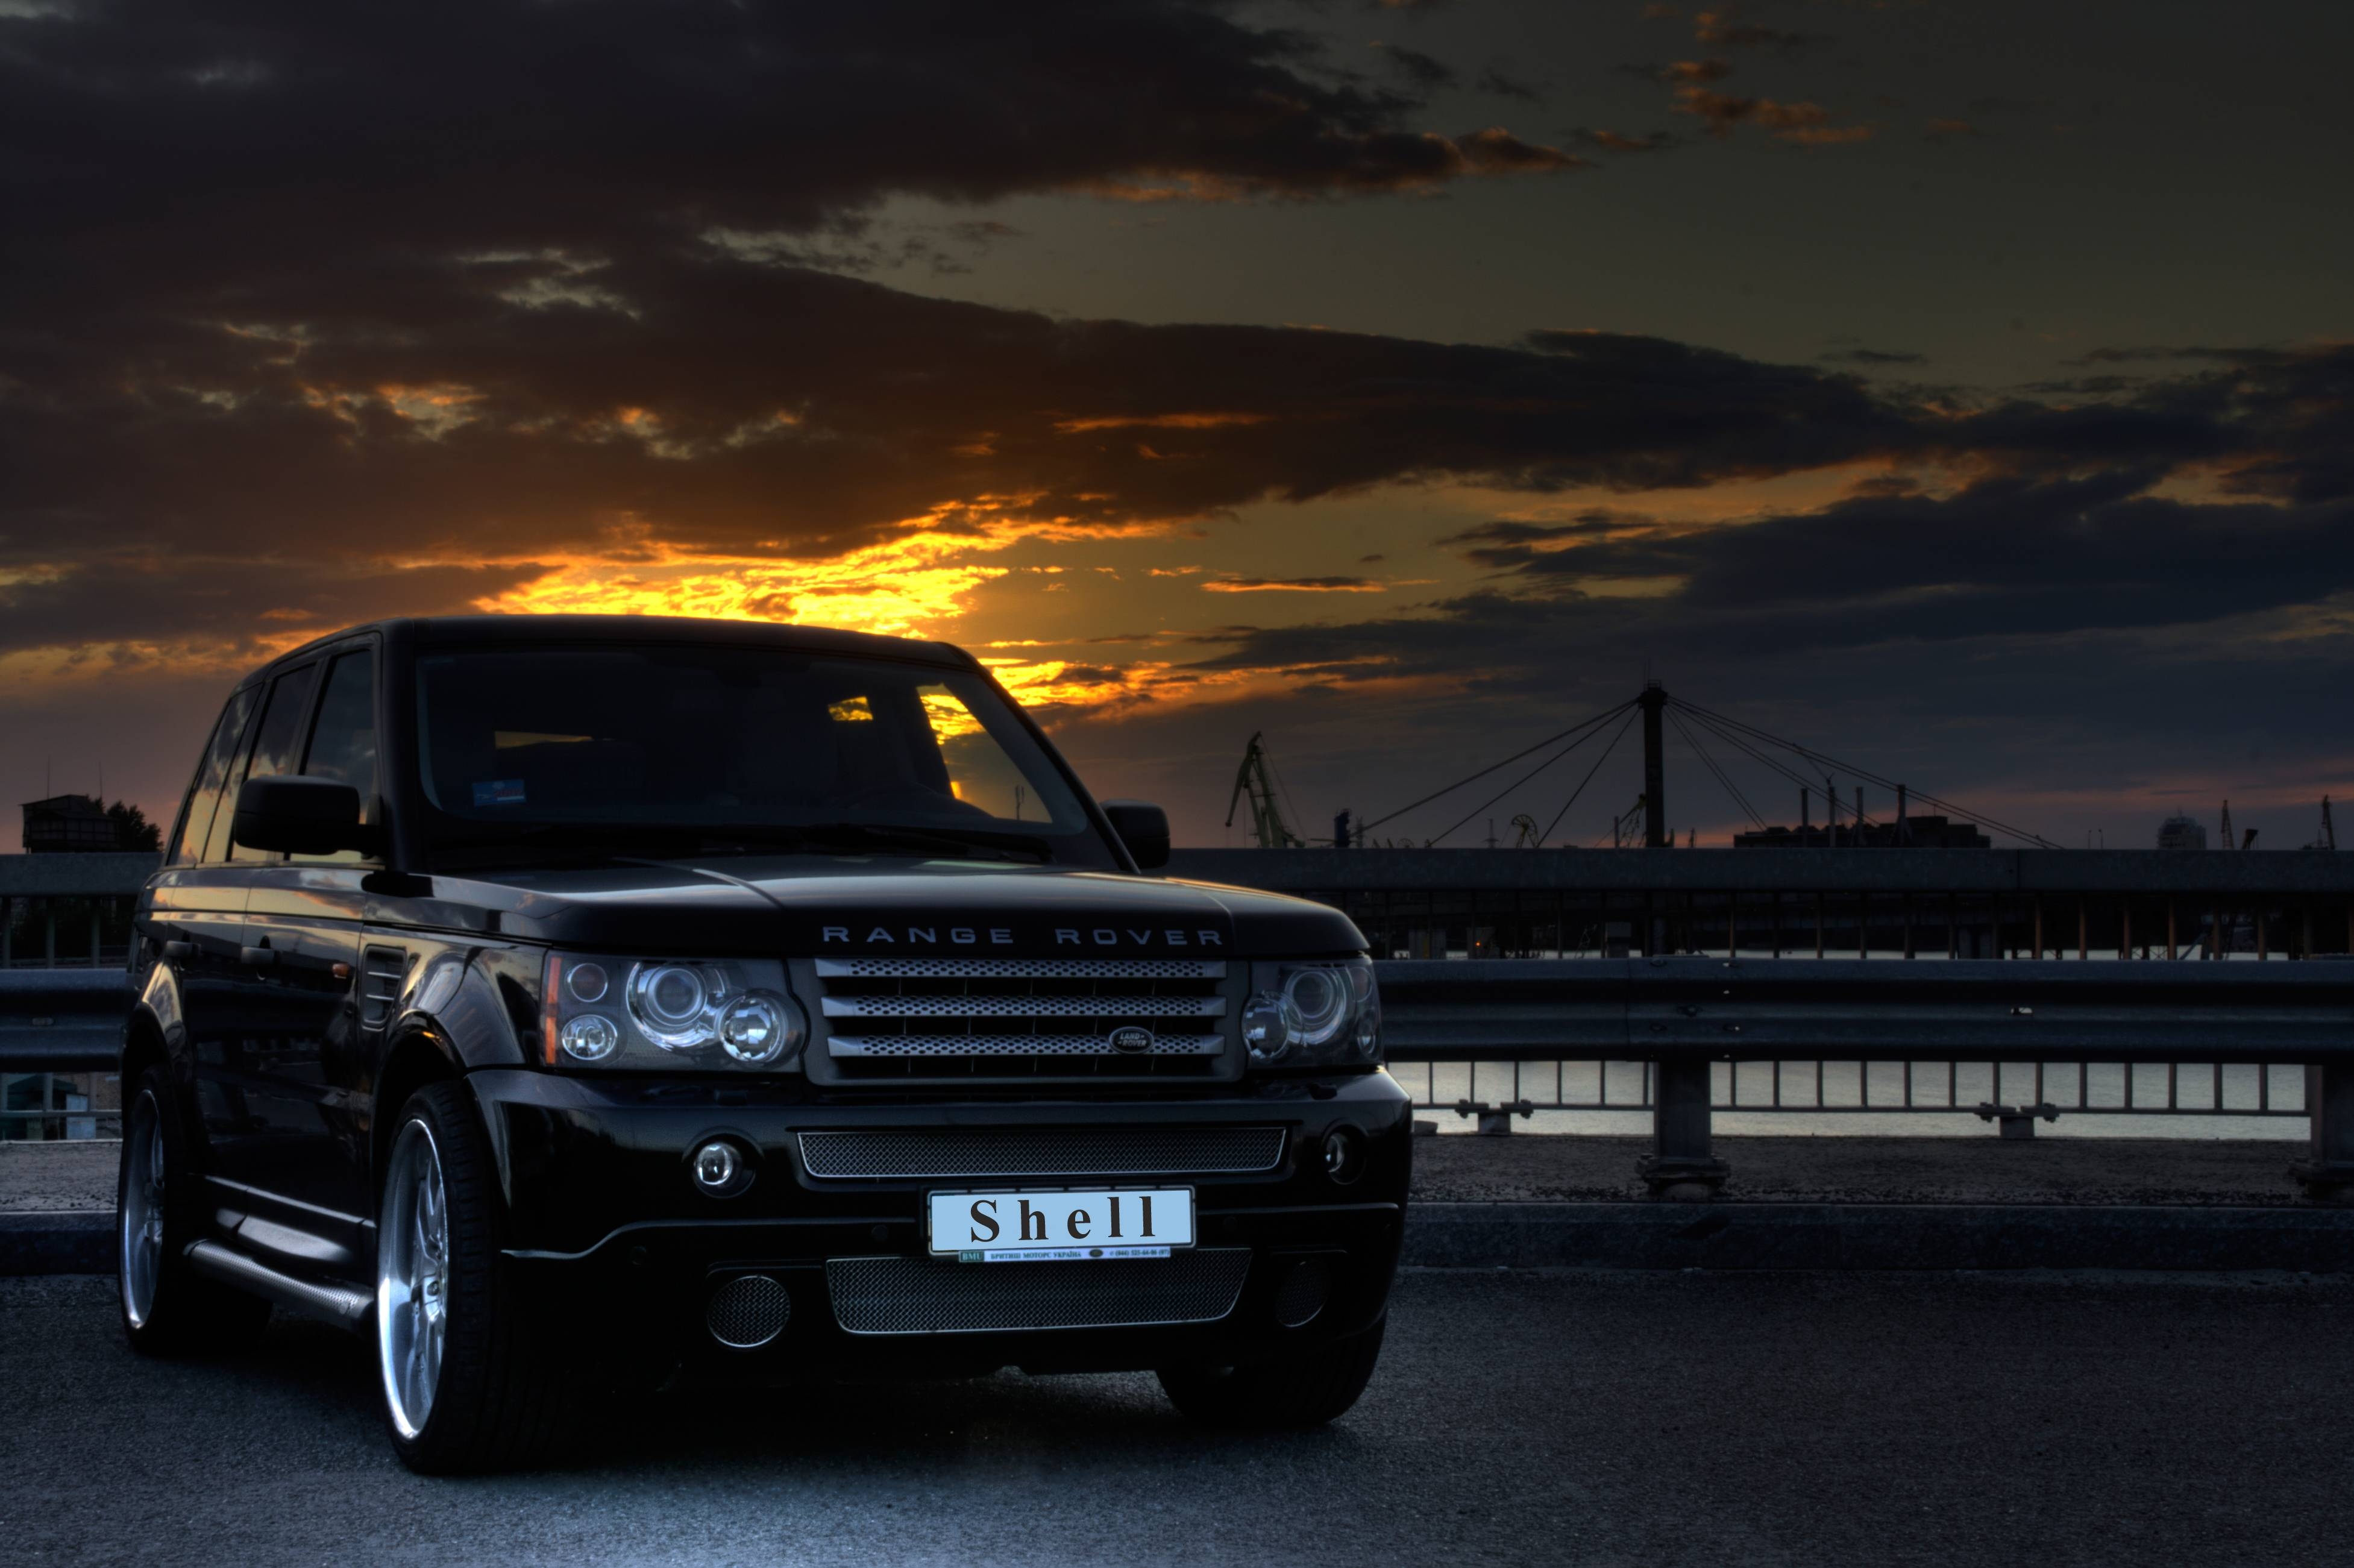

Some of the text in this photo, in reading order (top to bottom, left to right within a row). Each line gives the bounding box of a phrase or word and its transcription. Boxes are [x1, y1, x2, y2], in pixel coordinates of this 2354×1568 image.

[822, 926, 1223, 946] RANGE ROVER
[970, 1196, 1155, 1243] Shell
